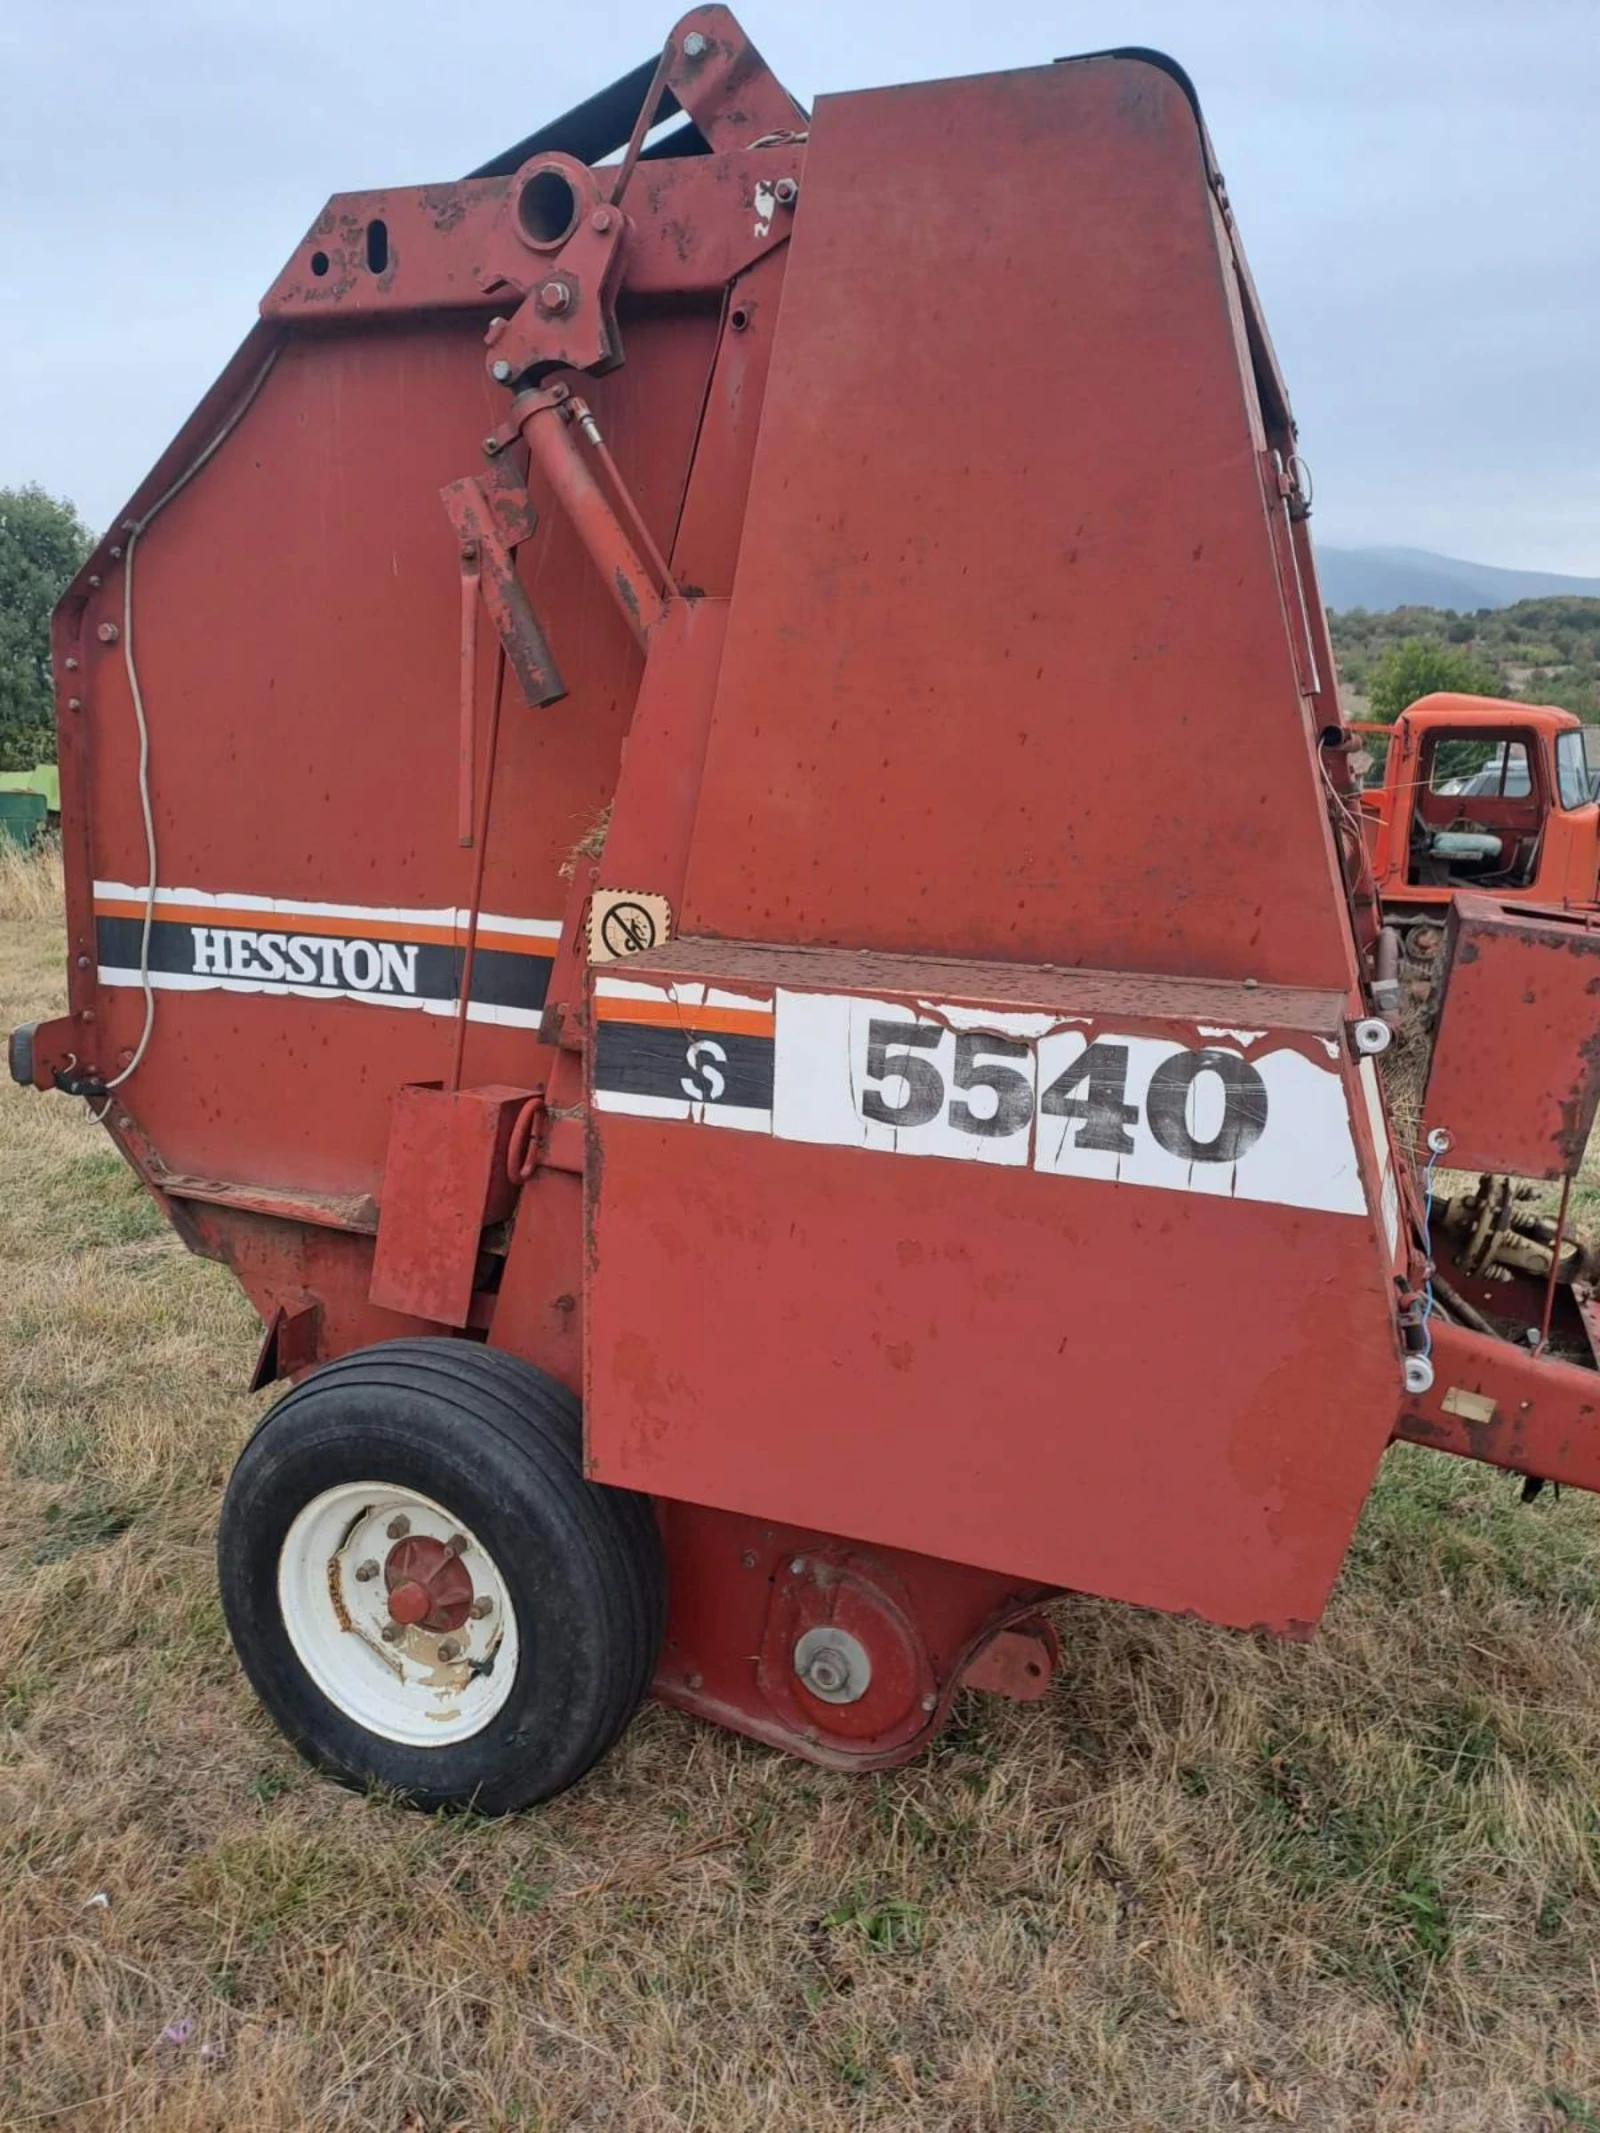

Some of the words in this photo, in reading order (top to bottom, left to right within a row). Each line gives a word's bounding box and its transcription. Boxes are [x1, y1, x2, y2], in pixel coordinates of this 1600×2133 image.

[191, 927, 420, 993] HESSTON
[680, 1040, 728, 1103] S
[861, 1018, 1269, 1164] 5540
